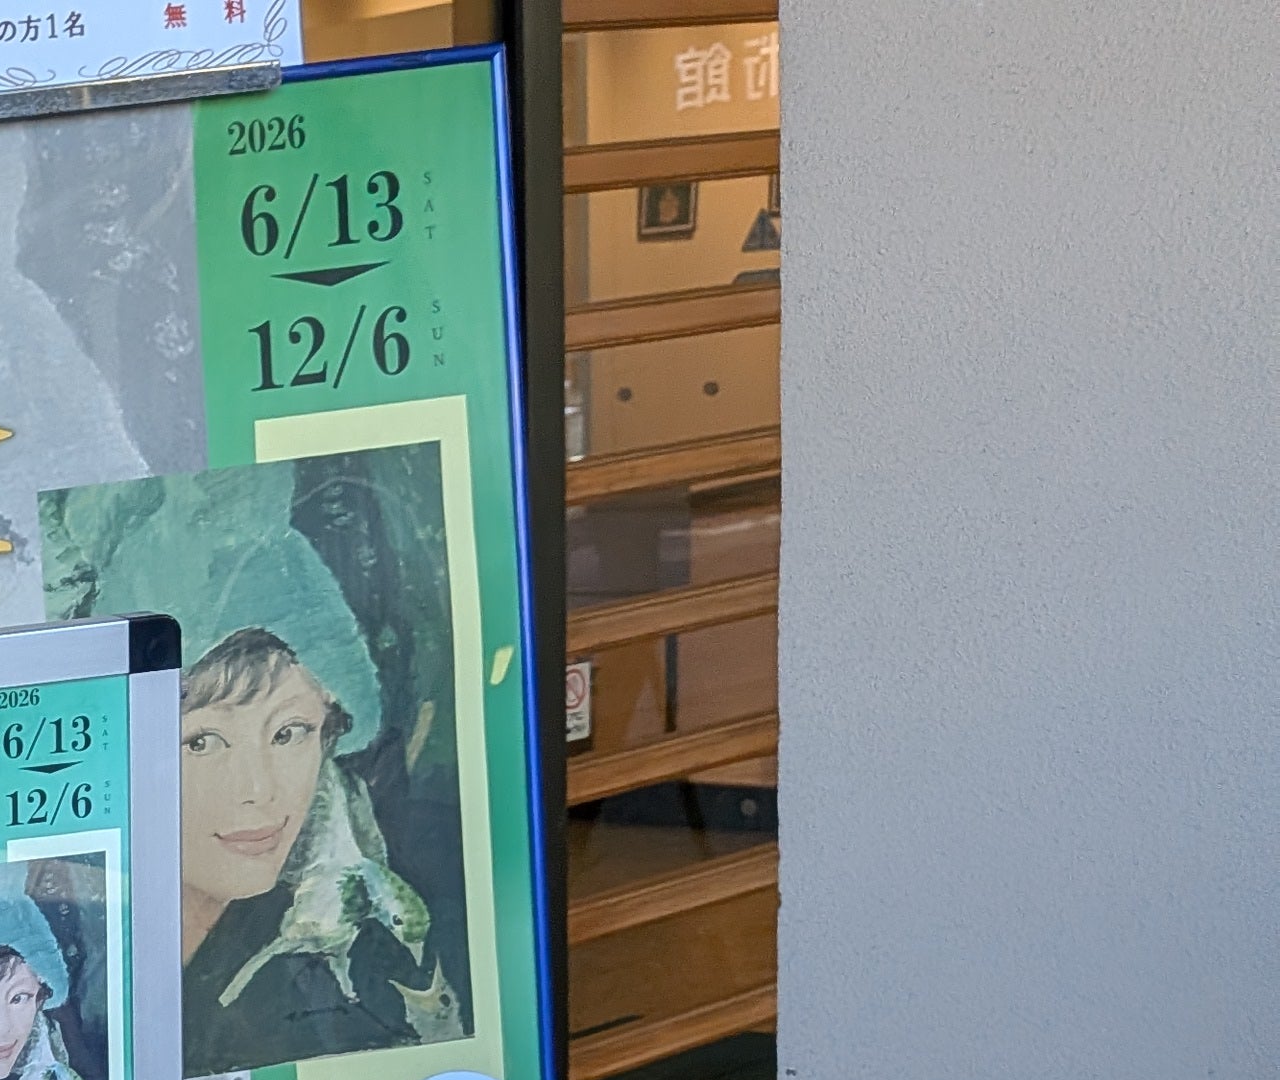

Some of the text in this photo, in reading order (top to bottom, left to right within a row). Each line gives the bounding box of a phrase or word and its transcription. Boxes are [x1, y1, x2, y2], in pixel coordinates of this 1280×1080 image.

[227, 114, 306, 156] 2026
[241, 170, 403, 260] 6/13
[423, 170, 436, 240] SAT
[247, 304, 411, 392] 12/6
[431, 299, 445, 367] SUN
[3, 715, 91, 760] 6/13
[5, 782, 93, 827] 12/6
